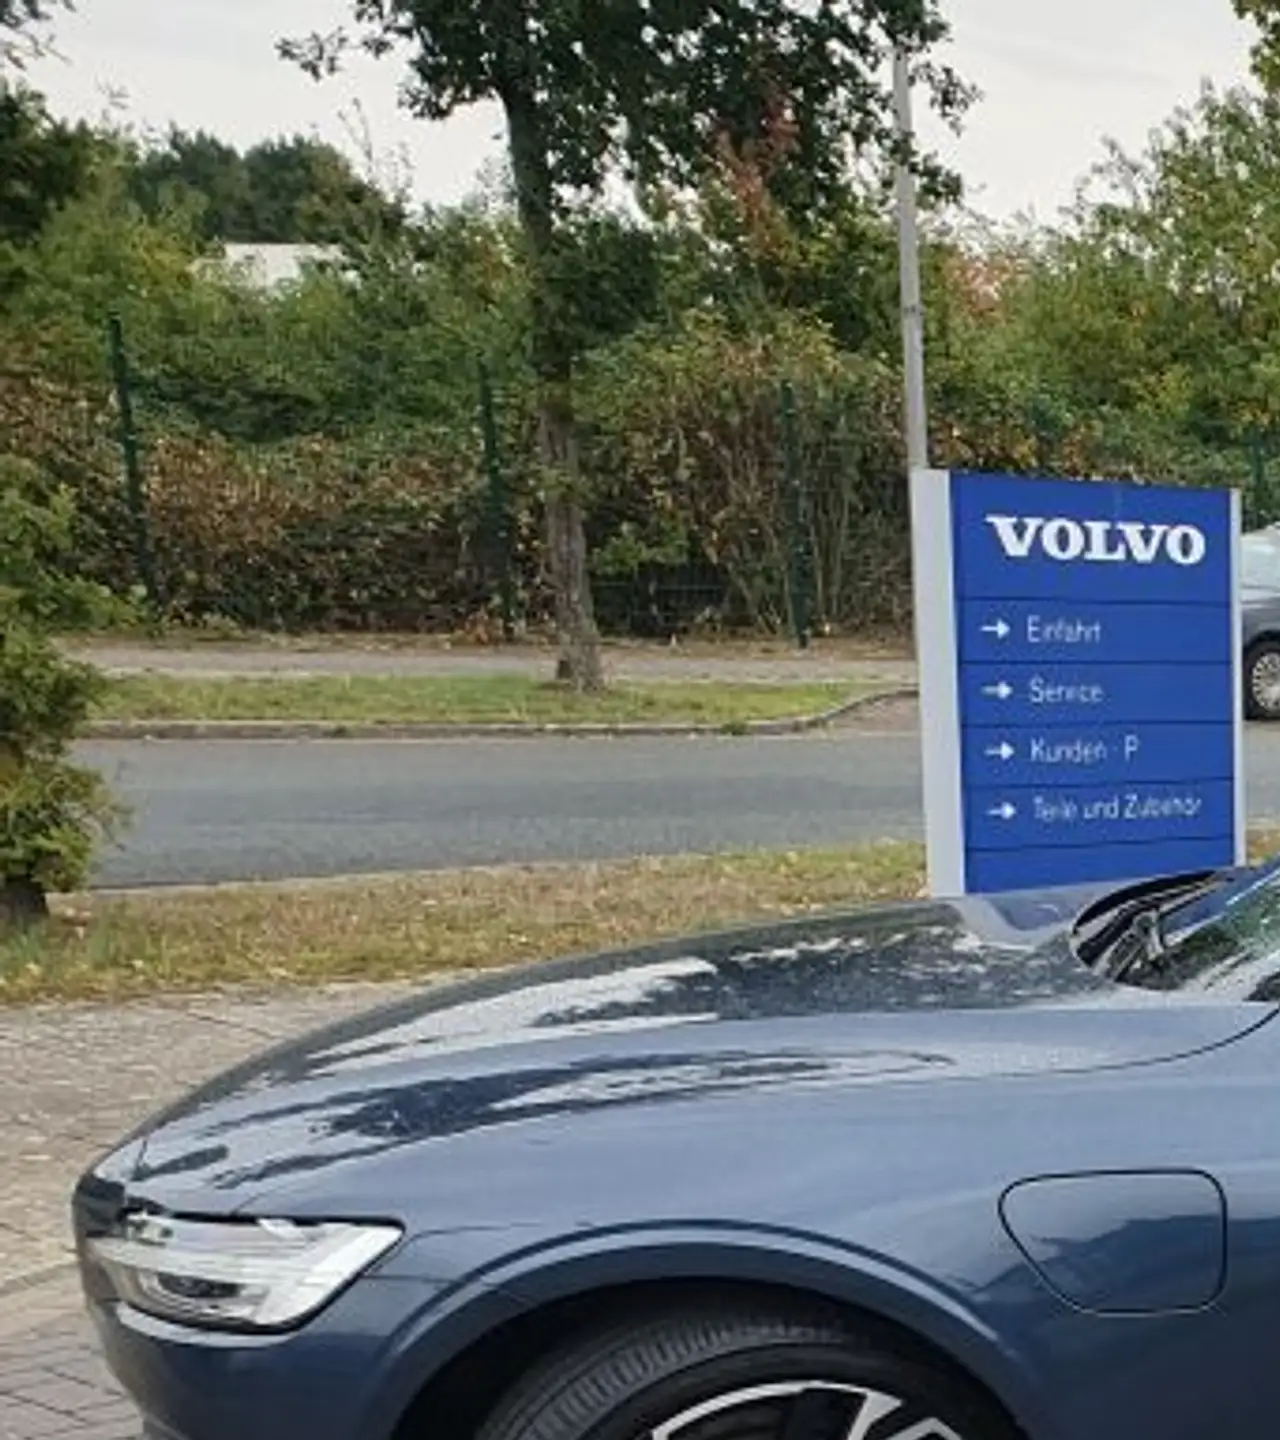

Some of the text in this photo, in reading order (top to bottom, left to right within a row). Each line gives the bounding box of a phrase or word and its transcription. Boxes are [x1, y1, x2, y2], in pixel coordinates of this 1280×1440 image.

[985, 514, 1206, 565] VOLVO
[1027, 615, 1101, 643] Einfahrt
[1030, 676, 1103, 703] Service
[1031, 737, 1107, 764] Kunden
[1084, 796, 1119, 820] und
